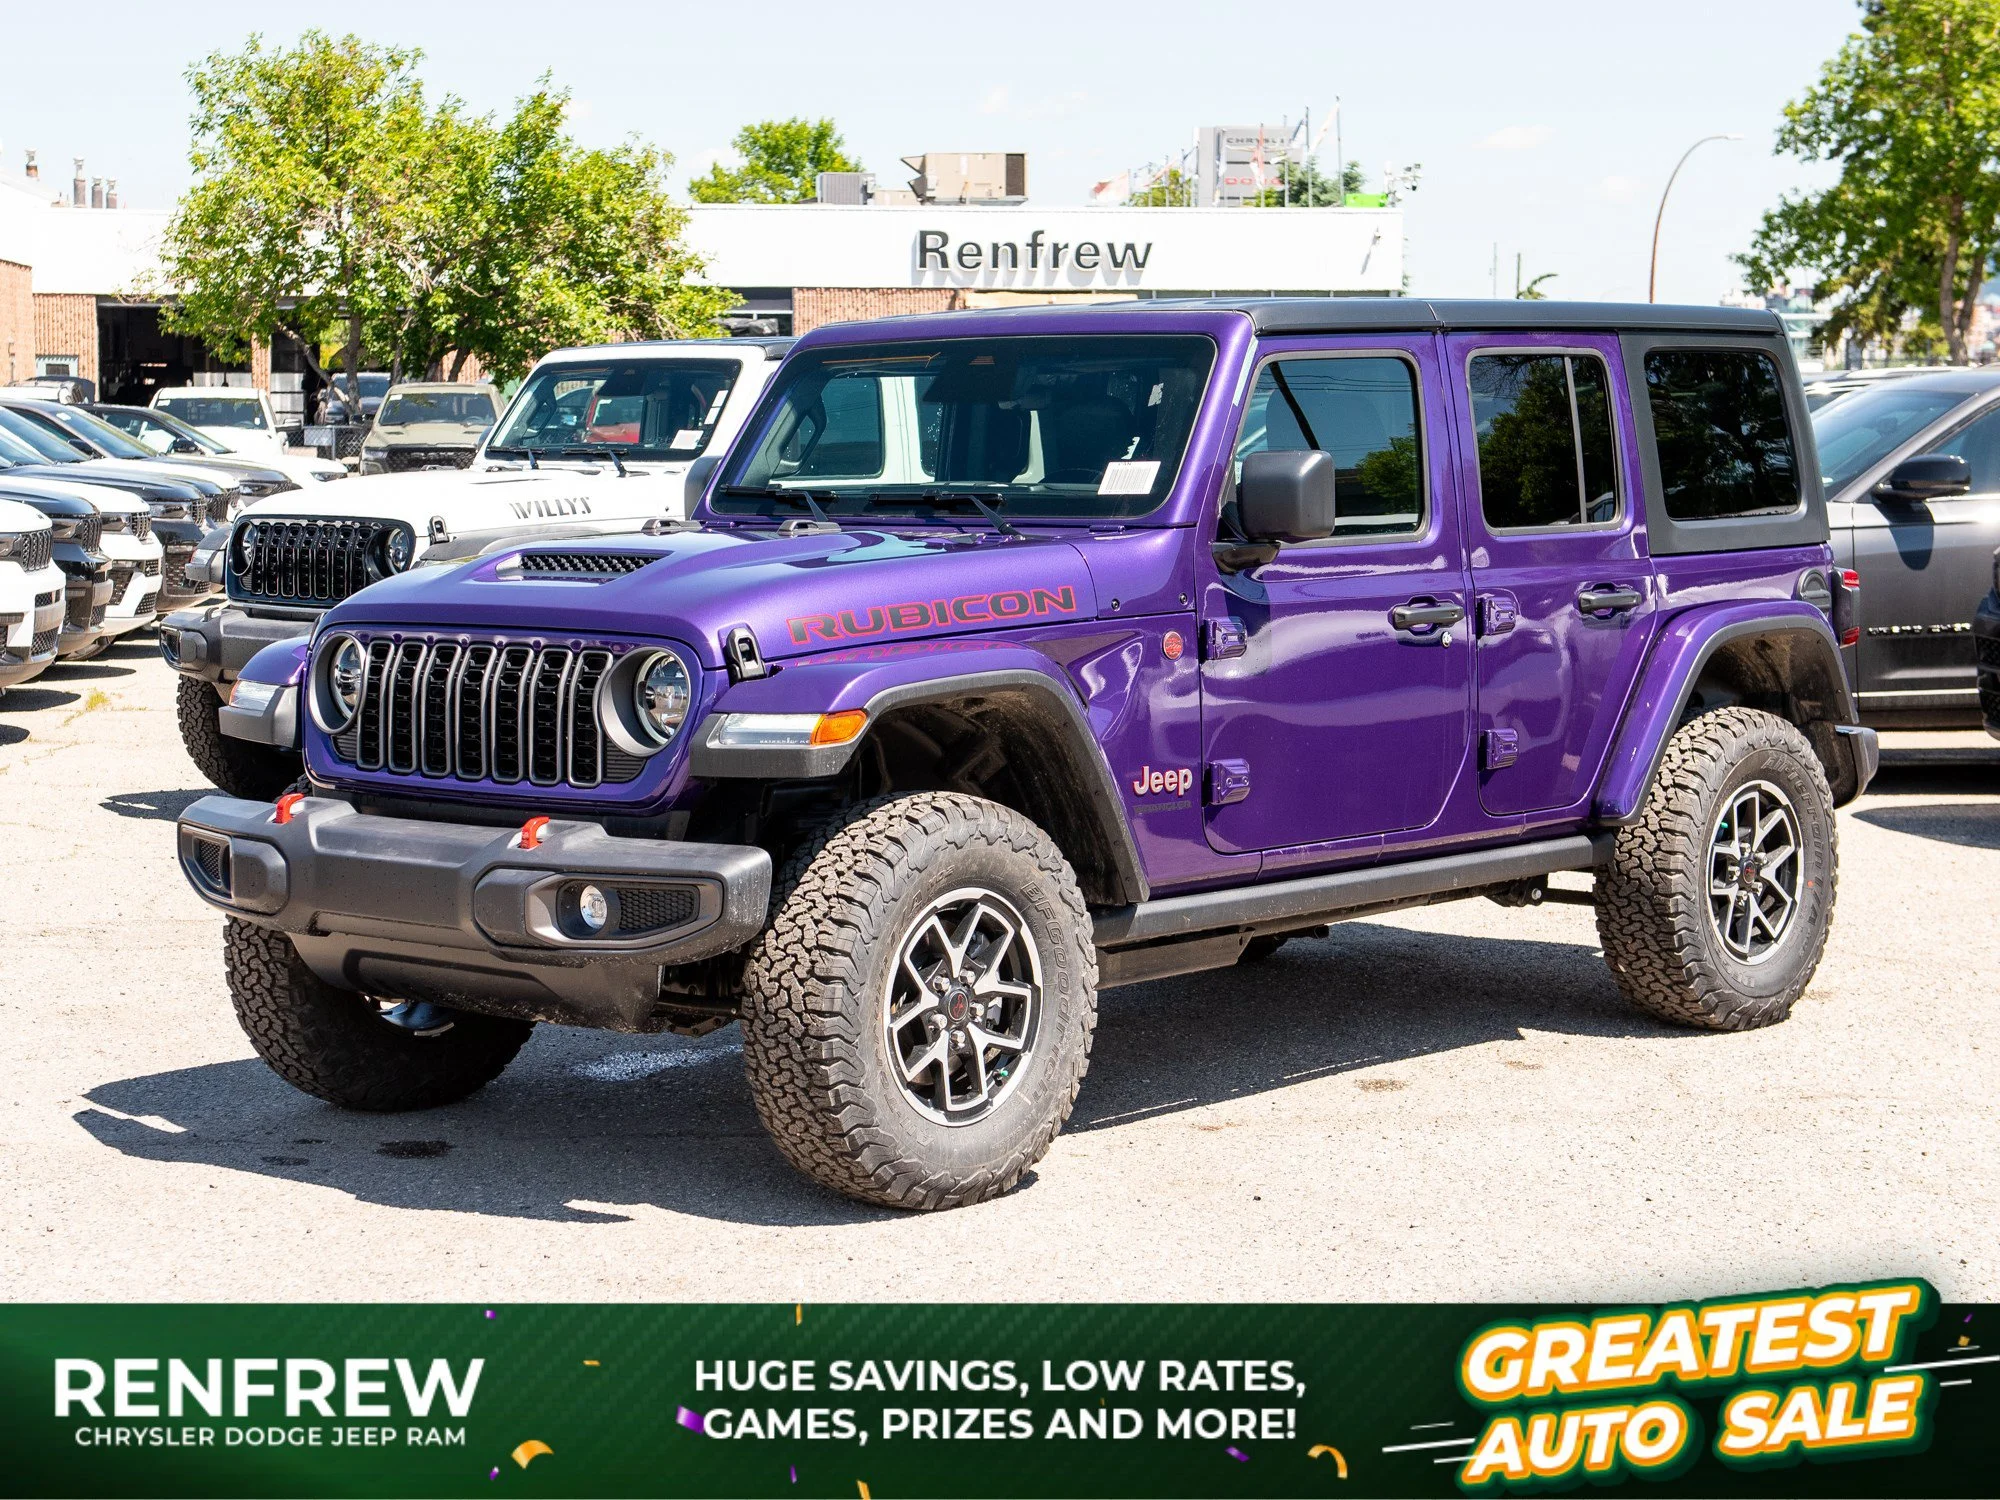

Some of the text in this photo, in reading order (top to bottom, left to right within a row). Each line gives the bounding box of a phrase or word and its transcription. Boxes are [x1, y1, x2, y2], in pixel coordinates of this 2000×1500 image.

[917, 230, 1153, 270] Renfrew
[786, 586, 1077, 645] RUBICON
[1133, 765, 1193, 798] Jeep
